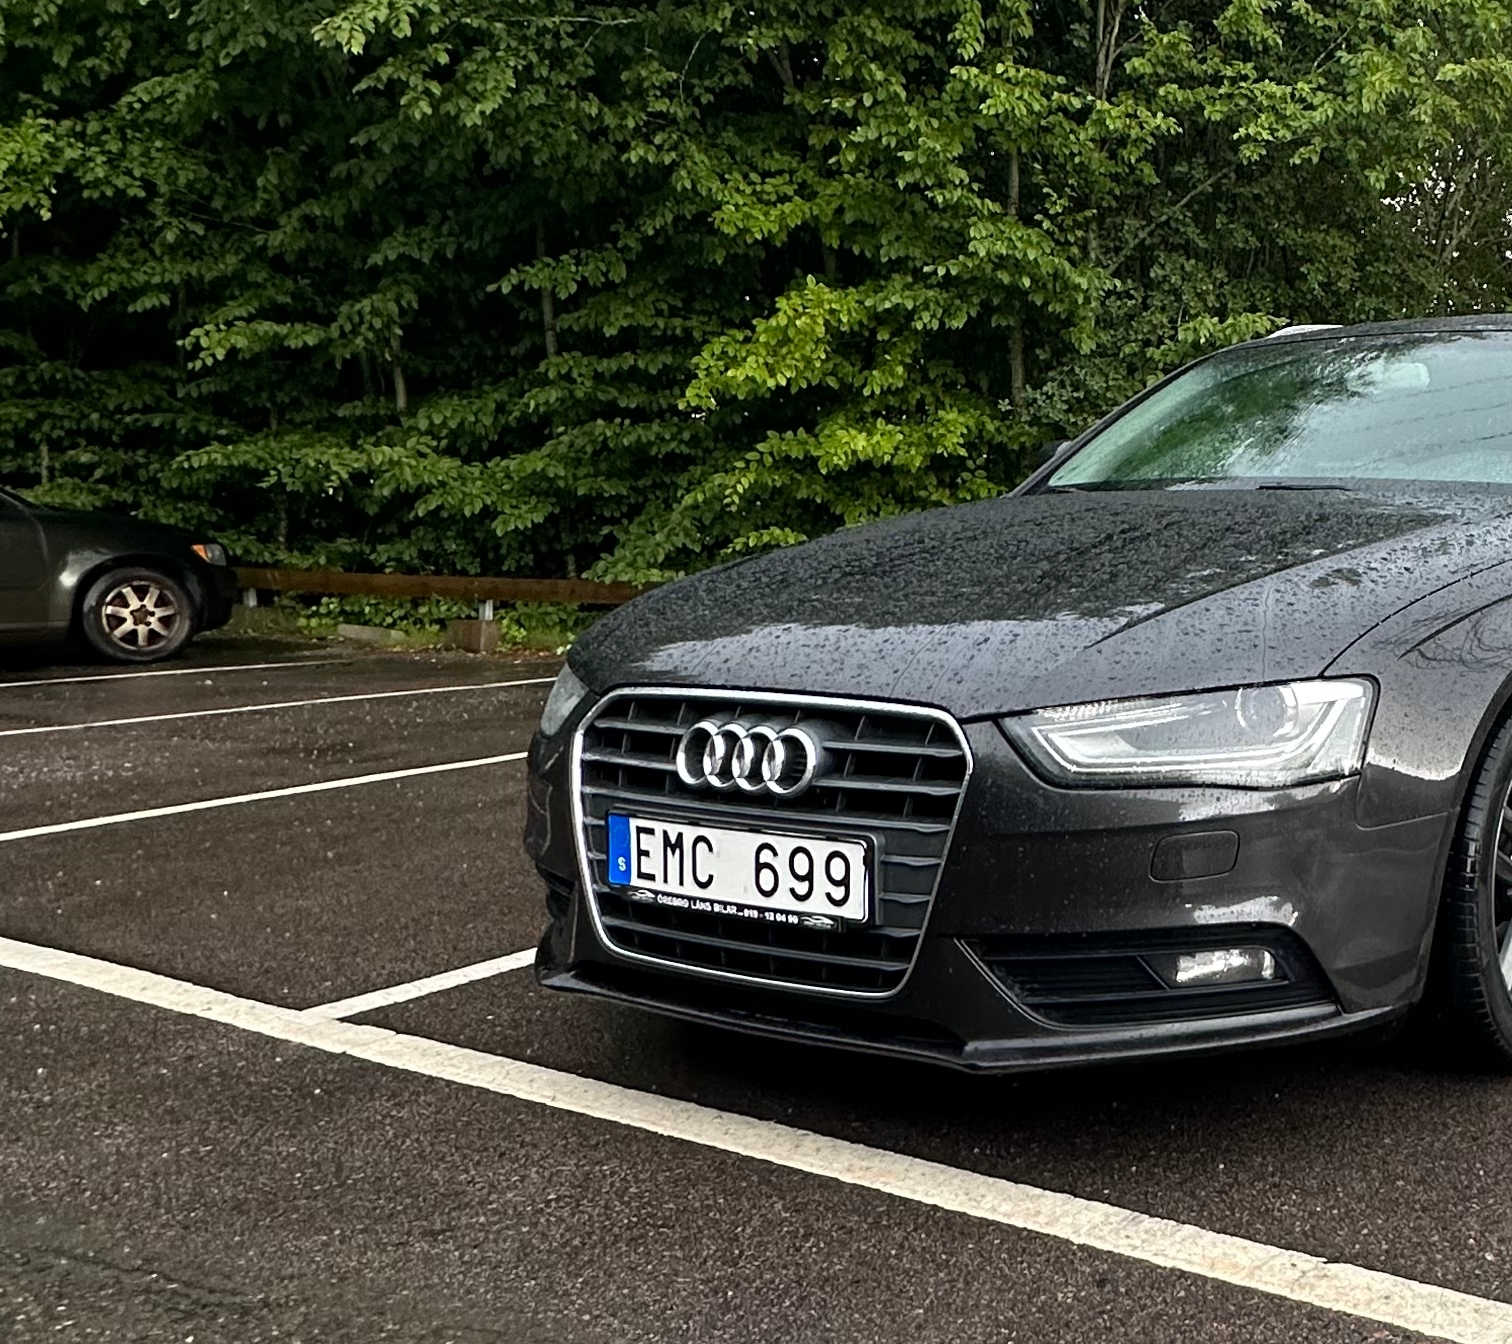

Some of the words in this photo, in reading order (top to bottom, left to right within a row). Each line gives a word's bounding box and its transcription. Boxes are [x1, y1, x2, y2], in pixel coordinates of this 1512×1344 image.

[617, 856, 627, 872] S
[636, 825, 714, 889] EMC
[754, 842, 851, 907] 699
